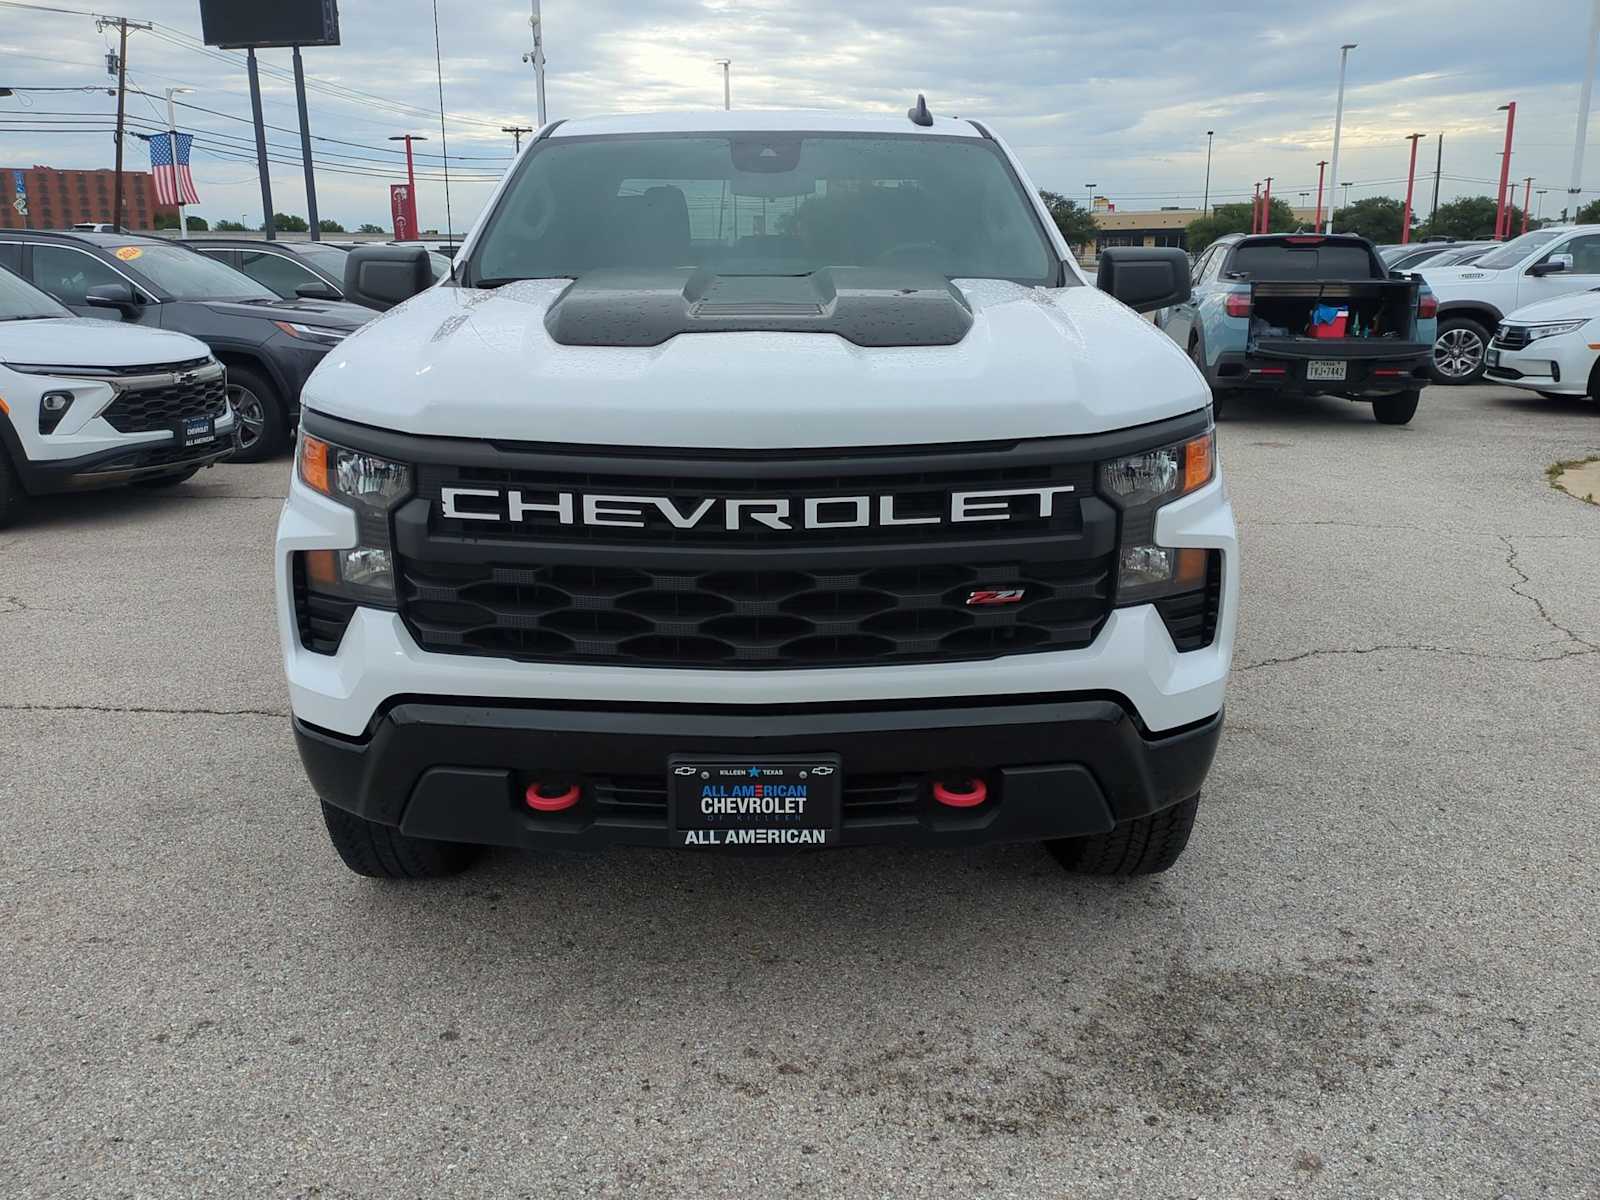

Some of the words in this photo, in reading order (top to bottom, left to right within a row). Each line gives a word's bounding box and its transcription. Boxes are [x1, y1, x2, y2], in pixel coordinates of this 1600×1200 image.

[441, 485, 1075, 530] CHEVROLET
[966, 589, 1025, 605] Z71
[702, 785, 728, 797] ALL
[732, 784, 807, 797] AMERICAN
[701, 797, 807, 814] CHEVROLET
[685, 830, 721, 845] ALL
[725, 829, 826, 844] AMERICAN
